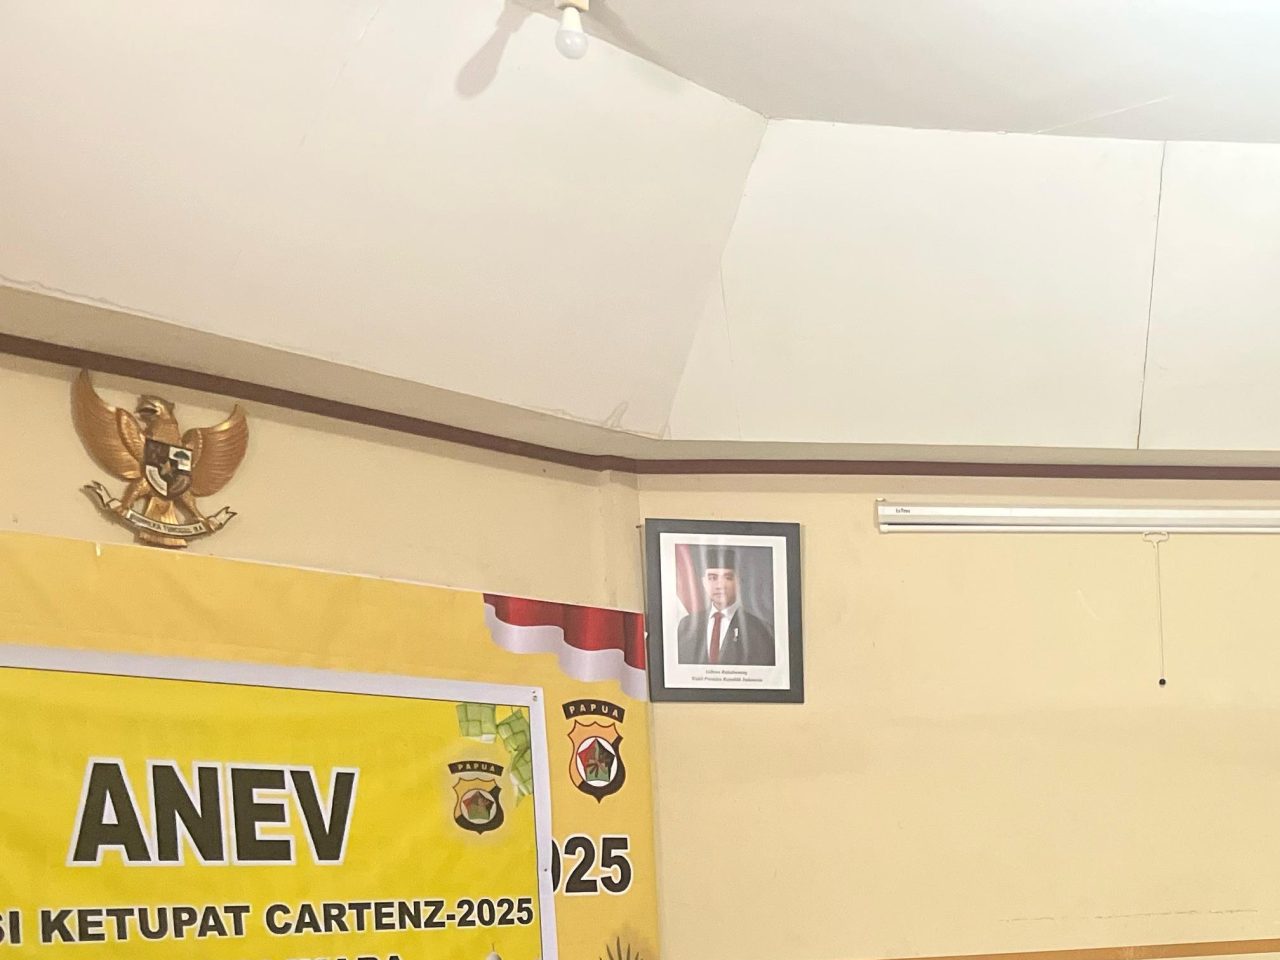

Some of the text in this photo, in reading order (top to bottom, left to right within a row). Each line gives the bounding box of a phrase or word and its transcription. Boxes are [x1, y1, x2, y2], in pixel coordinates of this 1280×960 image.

[568, 703, 619, 718] PAPUA
[457, 763, 495, 772] PAPUA
[70, 759, 357, 864] ANEV
[0, 897, 534, 945] I KETUPAT CARTENZ-2025
